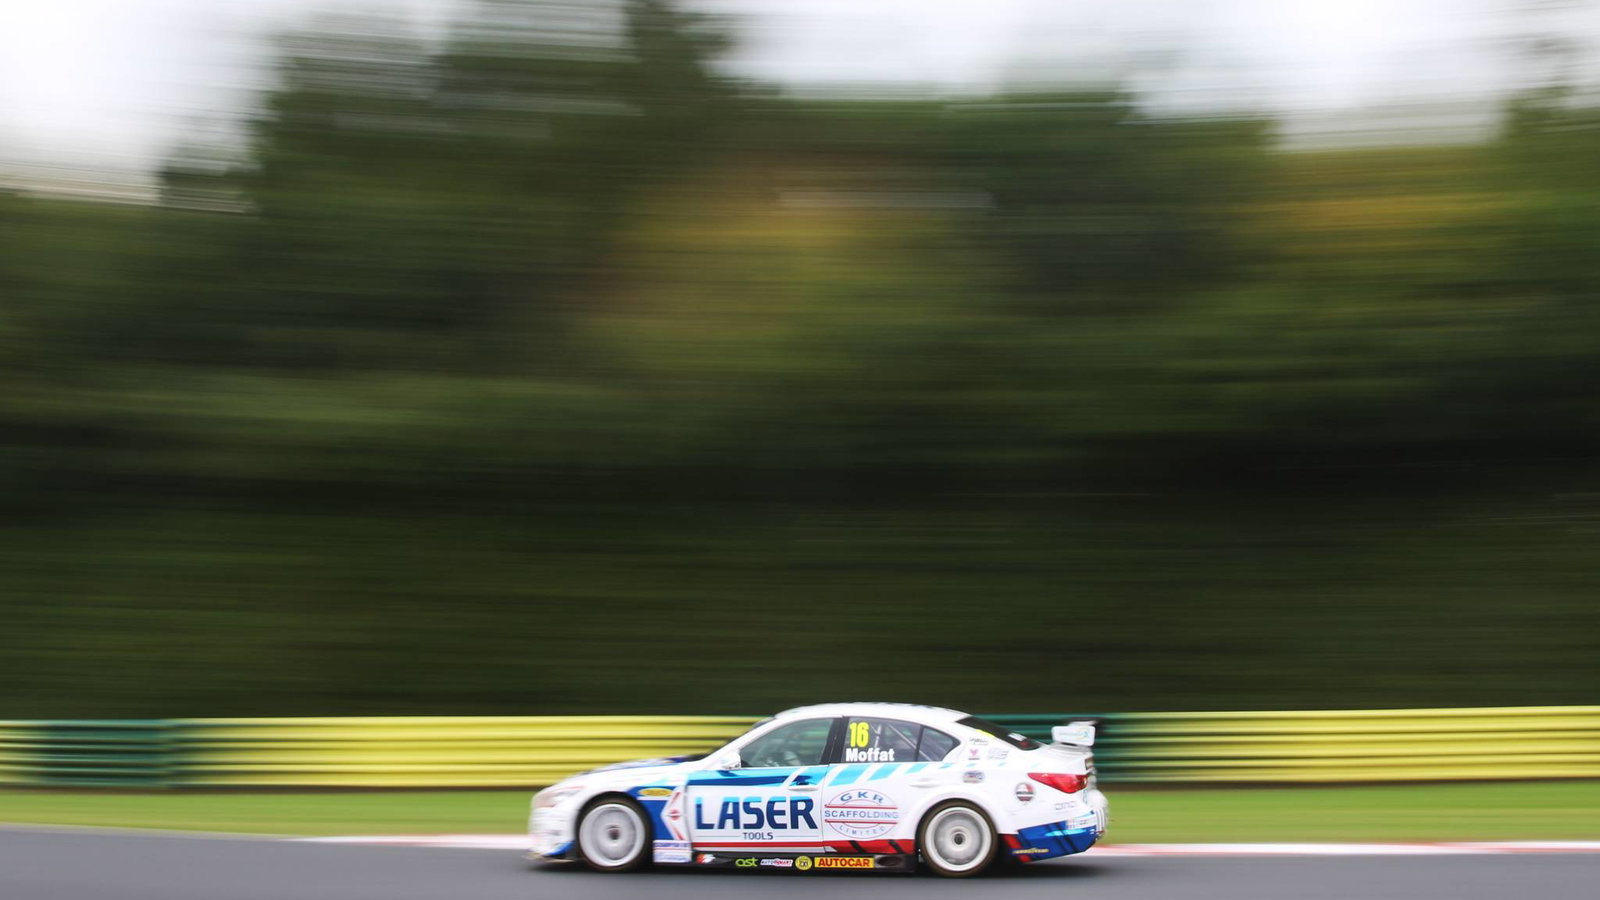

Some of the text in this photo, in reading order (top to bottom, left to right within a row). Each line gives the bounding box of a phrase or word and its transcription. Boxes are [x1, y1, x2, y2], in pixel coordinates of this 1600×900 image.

[849, 722, 869, 747] 16
[845, 747, 895, 762] Moffat
[840, 791, 884, 804] GKR
[695, 796, 818, 829] LASER
[824, 810, 899, 819] SCAFFOLDING
[742, 832, 774, 840] TOOLS
[818, 858, 870, 867] AUTOCAR
